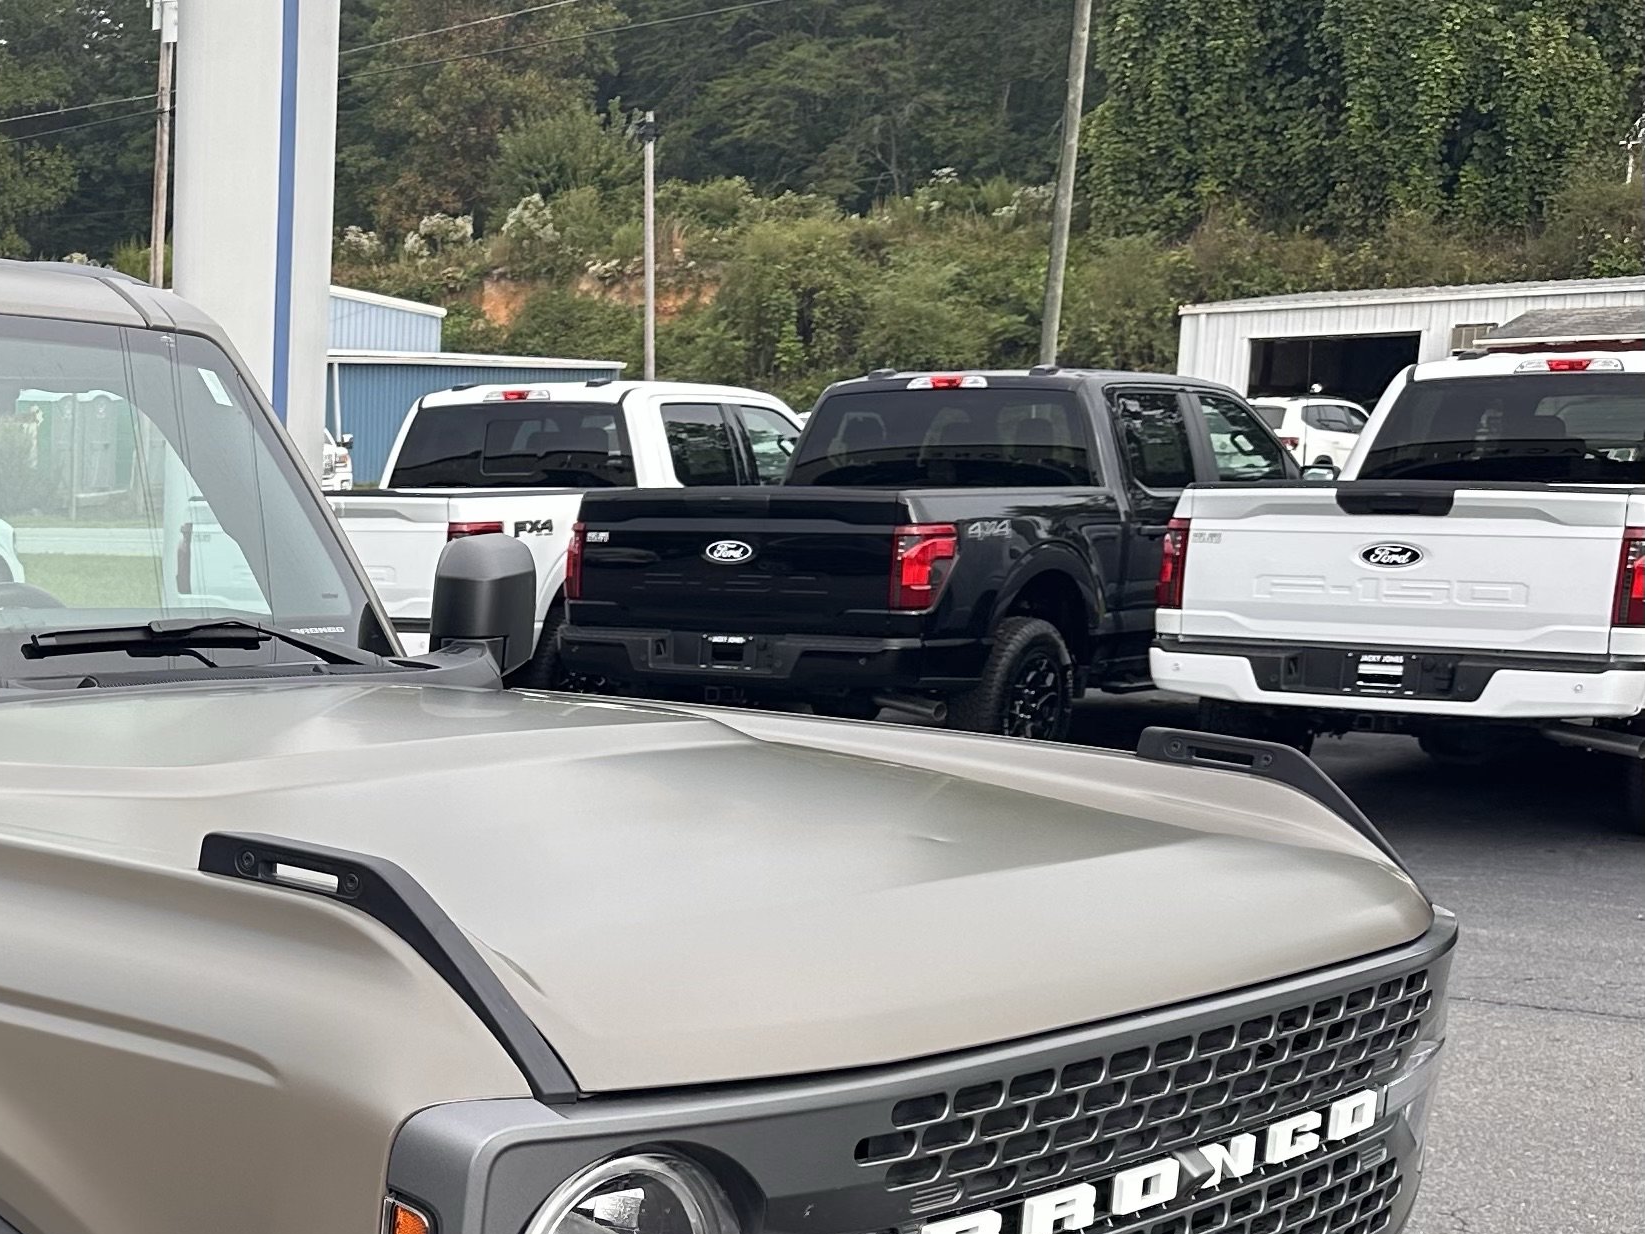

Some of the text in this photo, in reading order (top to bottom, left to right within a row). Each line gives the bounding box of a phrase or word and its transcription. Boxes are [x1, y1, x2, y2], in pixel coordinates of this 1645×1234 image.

[514, 519, 553, 538] FX4
[713, 543, 744, 558] Ford
[1369, 546, 1411, 564] Ford
[1253, 574, 1530, 608] F-150
